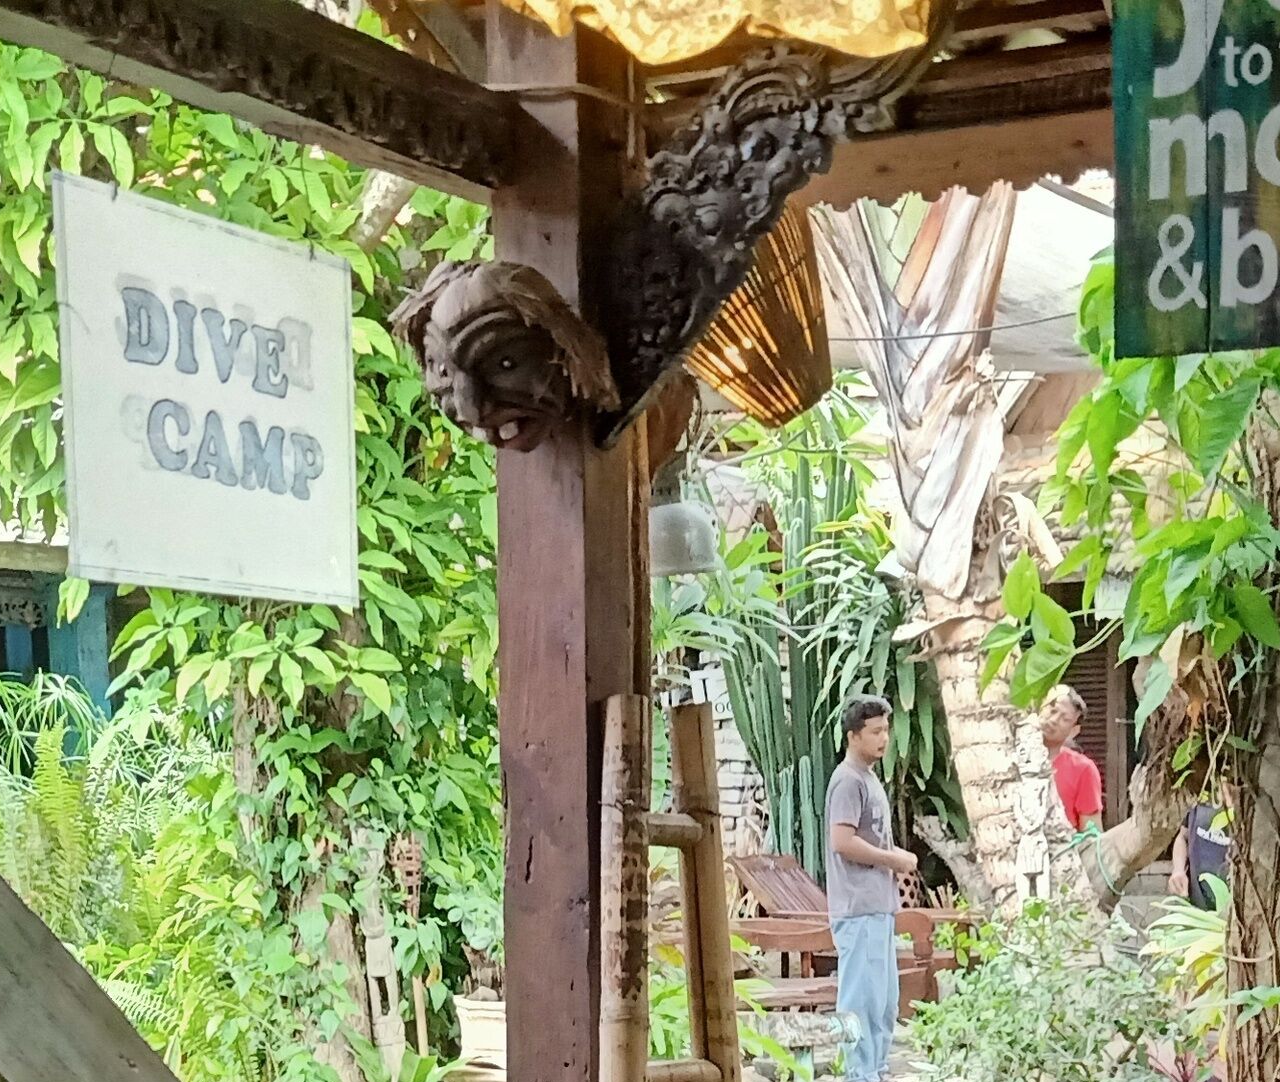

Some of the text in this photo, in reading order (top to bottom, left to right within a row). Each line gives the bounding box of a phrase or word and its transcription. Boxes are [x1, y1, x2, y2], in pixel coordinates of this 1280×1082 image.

[1221, 46, 1273, 87] to
[121, 287, 289, 399] DIVE
[148, 398, 324, 500] CAMP
